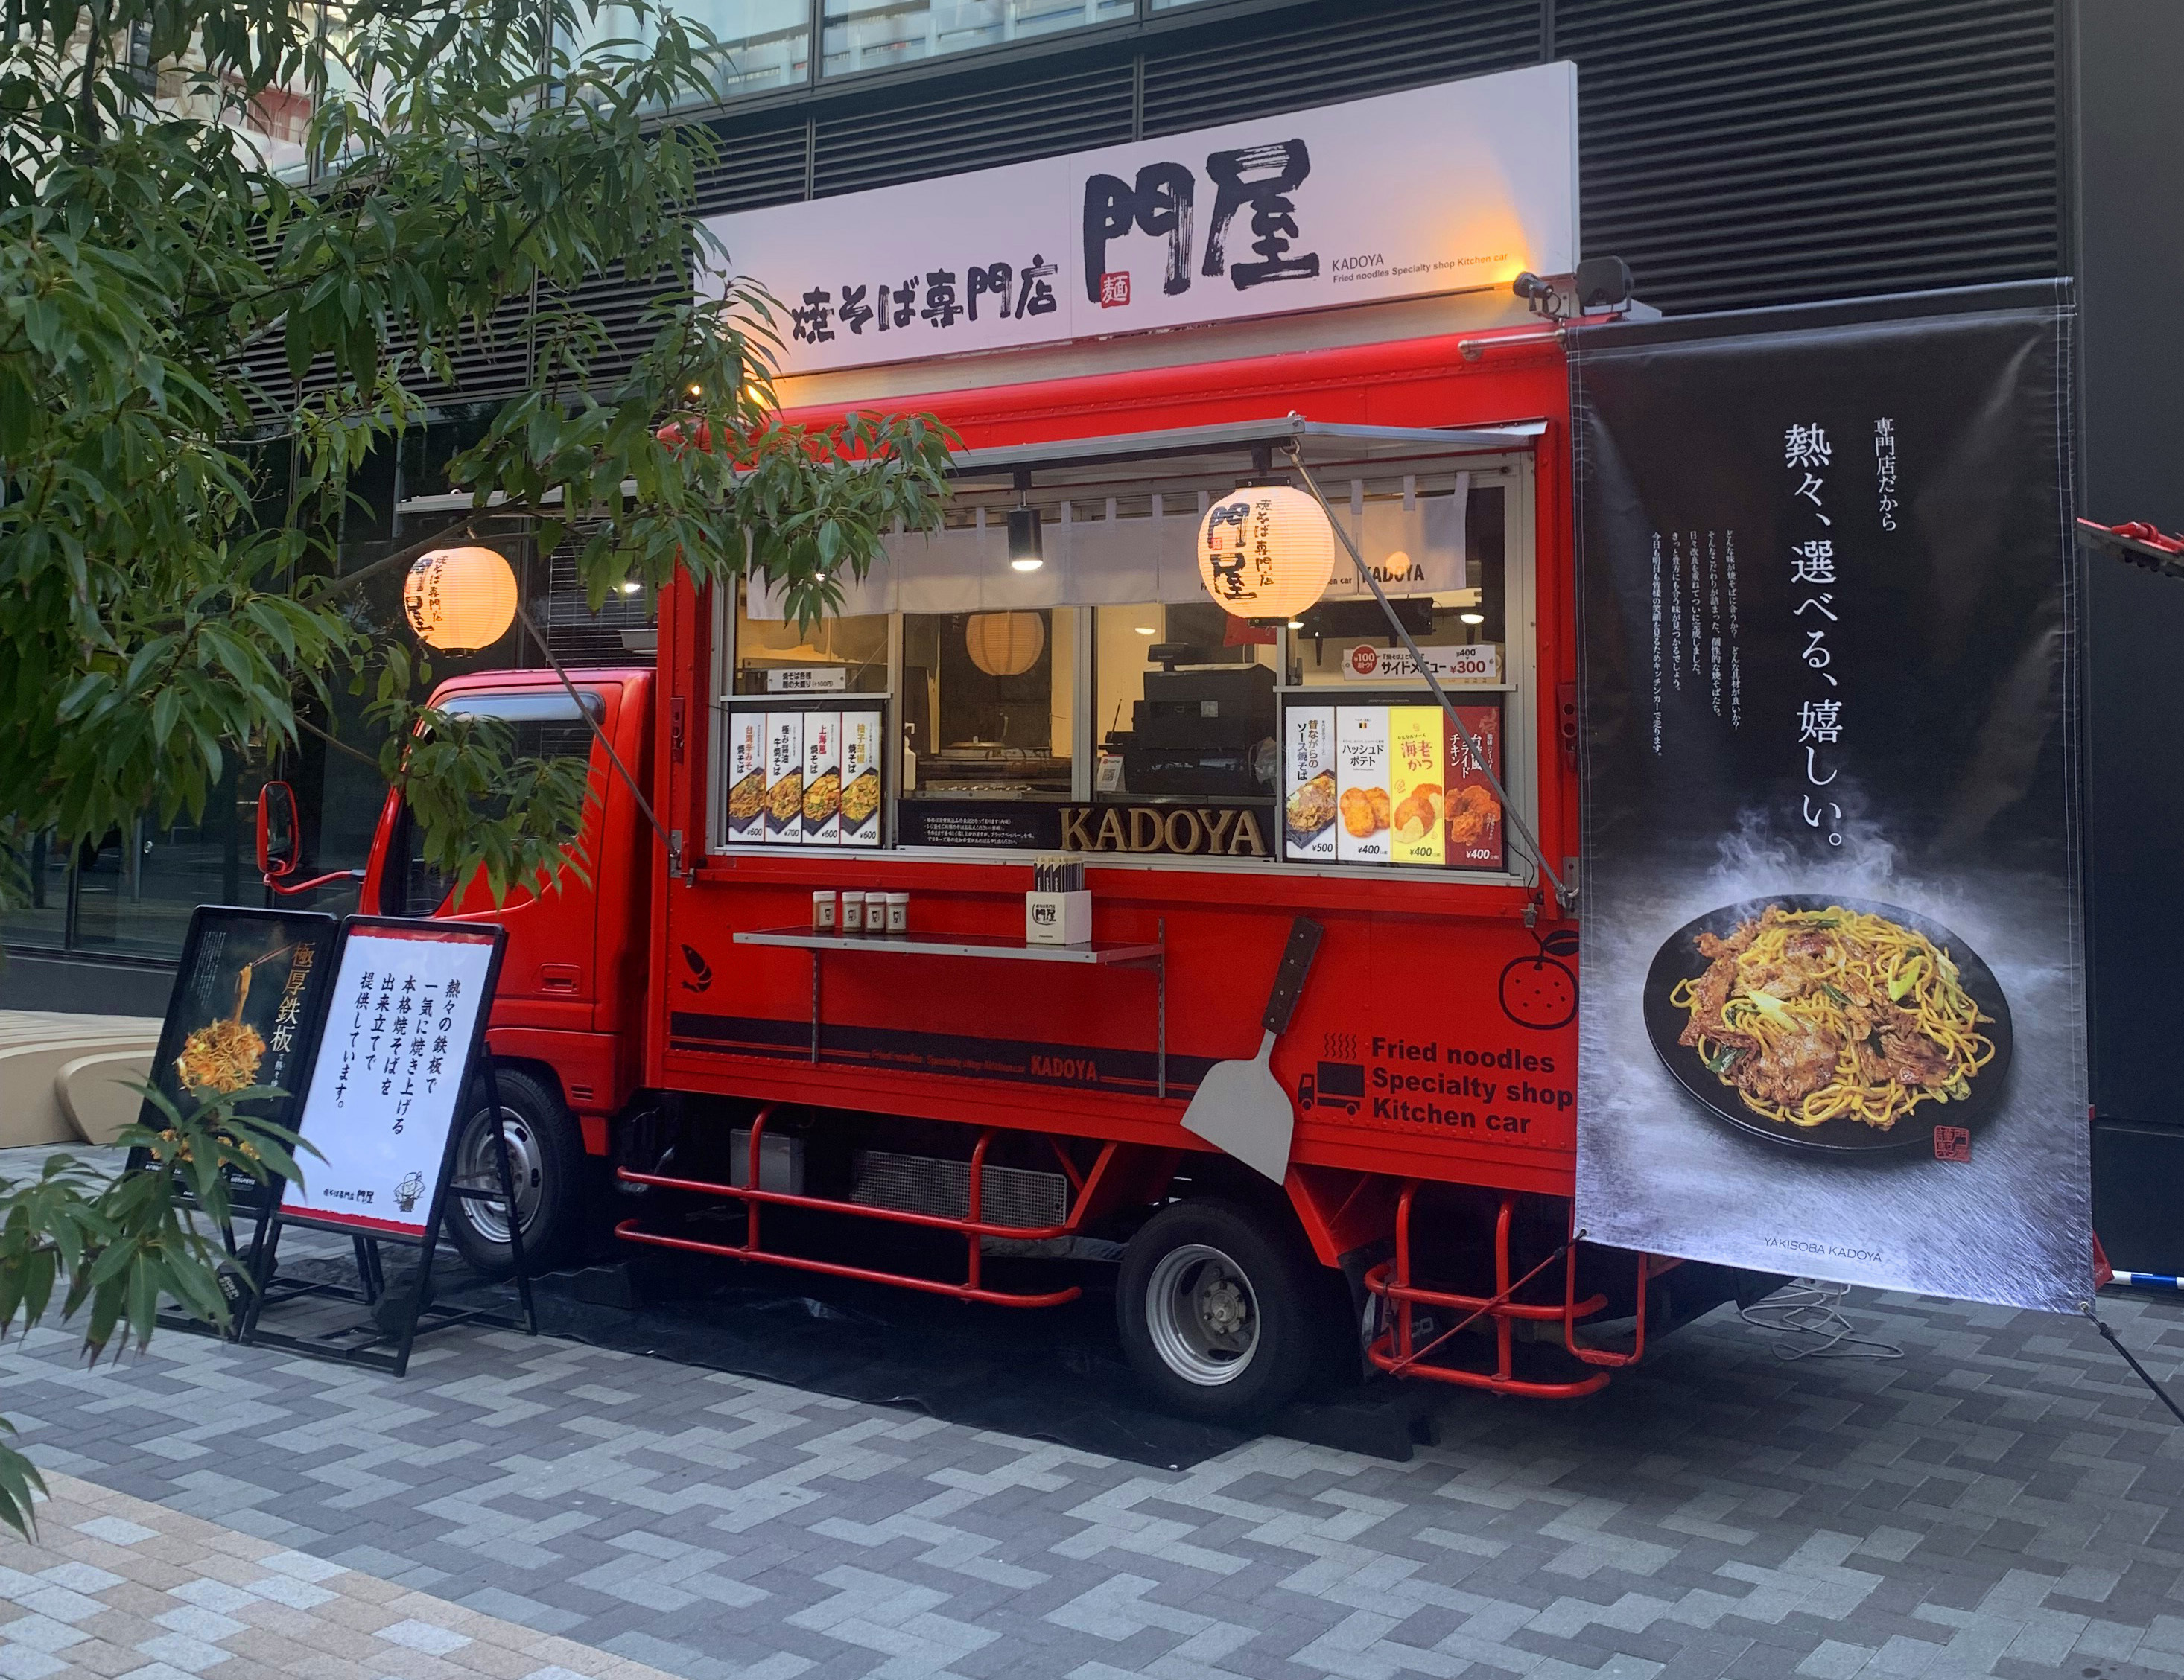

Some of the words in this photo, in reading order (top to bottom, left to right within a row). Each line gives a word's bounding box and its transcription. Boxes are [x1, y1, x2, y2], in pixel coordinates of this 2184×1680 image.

[1084, 138, 1319, 304] 門屋
[1332, 253, 1385, 272] KADOYA
[1333, 273, 1354, 284] Fried
[1356, 268, 1390, 280] noodles
[1391, 262, 1432, 276] Specialty
[1433, 259, 1456, 270] shop
[1457, 254, 1492, 267] Kitchen
[1493, 253, 1508, 262] car
[791, 252, 1058, 344] 焼そば専門店
[1102, 273, 1129, 304] 麺
[1873, 416, 1899, 532] 専門店だから
[1207, 502, 1258, 600] 門屋
[1784, 423, 1844, 847] 熱々、選べる、嬉しい。
[1450, 660, 1486, 674] ¥300
[1297, 723, 1308, 781] ソース焼そば
[1308, 719, 1319, 769] 昔ながらの
[1342, 745, 1384, 755] ハッシュド
[1350, 756, 1376, 766] ポテト
[1400, 740, 1432, 758] 海老
[1450, 733, 1461, 766] チキン
[1461, 739, 1470, 779] ライド
[1407, 759, 1433, 771] かつ
[1058, 807, 1266, 856] KADOYA
[1312, 843, 1333, 853] ¥500
[1358, 844, 1380, 855] ¥400
[1409, 847, 1432, 857] ¥400
[1466, 849, 1490, 859] ¥400
[334, 971, 374, 1109] 提供しています。
[365, 973, 395, 1071] 出来立てで
[381, 975, 416, 1095] 本格焼そばを
[426, 979, 461, 1094] 熱々の鉄板で
[392, 983, 438, 1135] 一気に焼き上げる
[1030, 1055, 1098, 1081] KADOYA
[1371, 1036, 1437, 1063] Fried
[1447, 1048, 1555, 1074] noodles
[1371, 1066, 1497, 1103] Specialty
[1506, 1081, 1573, 1112] shop
[1373, 1097, 1476, 1129] Kitchen
[1485, 1113, 1531, 1134] car
[1764, 1236, 1826, 1256] YAKISOBA
[1829, 1245, 1882, 1263] KADOYA
